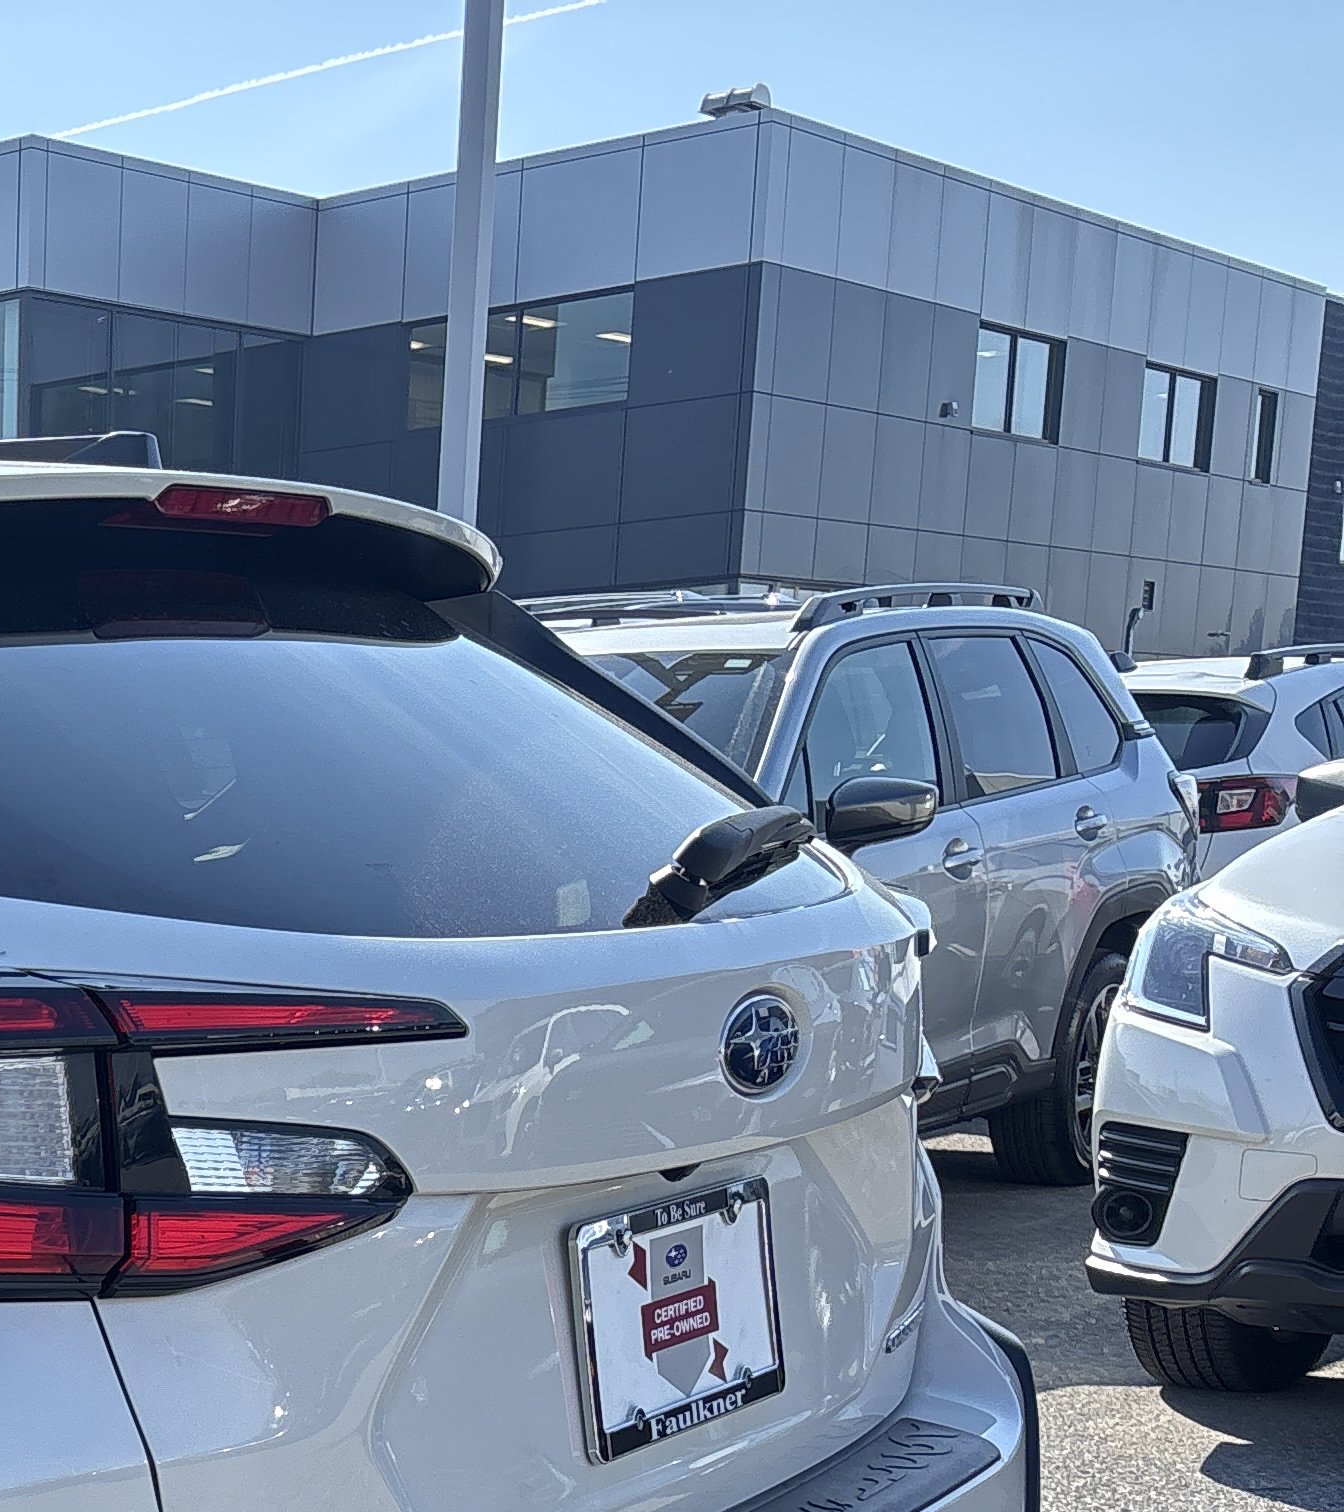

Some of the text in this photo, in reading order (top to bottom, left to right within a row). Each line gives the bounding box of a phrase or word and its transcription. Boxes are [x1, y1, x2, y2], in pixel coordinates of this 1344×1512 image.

[655, 1200, 706, 1226] To Be Sure
[663, 1269, 692, 1286] SUBARU
[654, 1295, 704, 1324] CERTIFIED
[650, 1312, 711, 1345] PRE-OWNED
[649, 1388, 747, 1441] Faulkner
